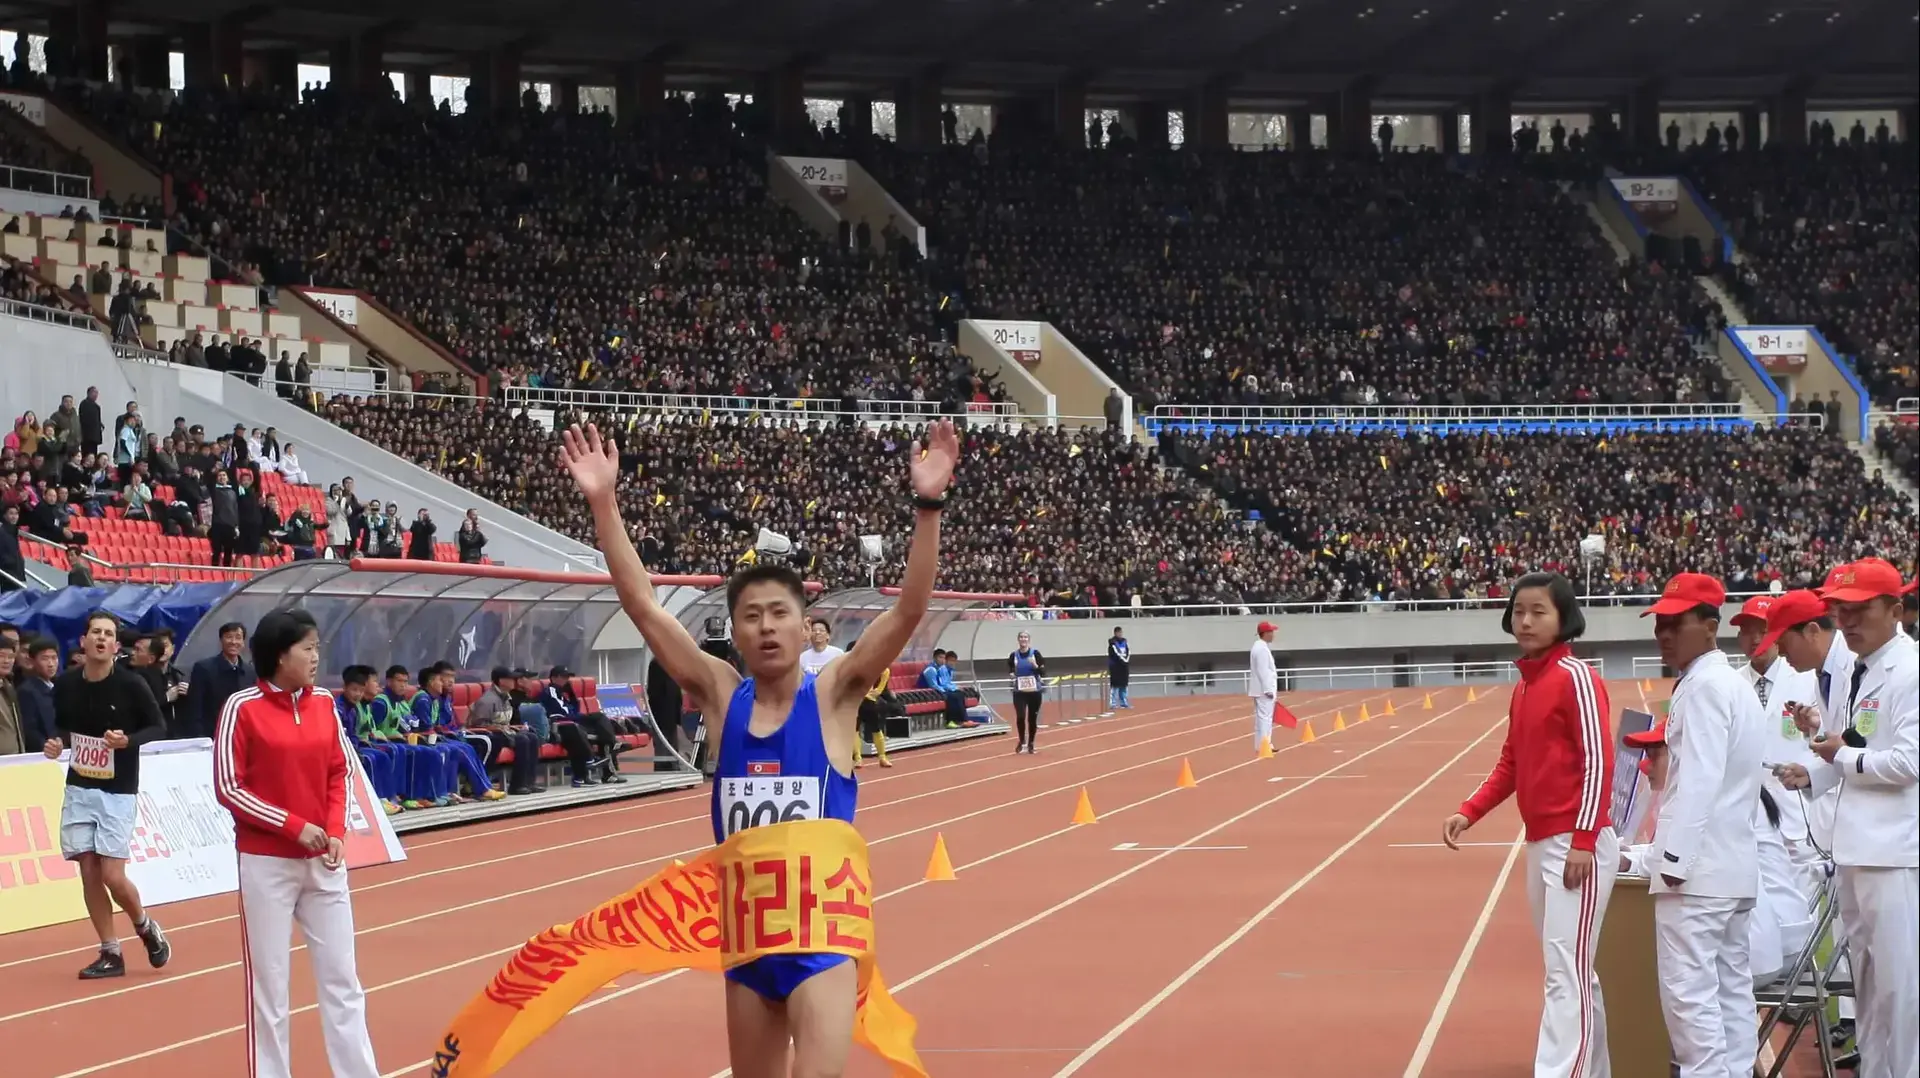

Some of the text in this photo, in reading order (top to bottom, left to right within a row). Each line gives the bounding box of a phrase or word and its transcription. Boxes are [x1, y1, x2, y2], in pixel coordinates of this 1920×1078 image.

[801, 165, 827, 181] 20-2
[1630, 182, 1655, 197] 19-2
[993, 328, 1020, 344] 20-1
[1757, 334, 1782, 349] 19-1
[74, 744, 110, 769] 2096
